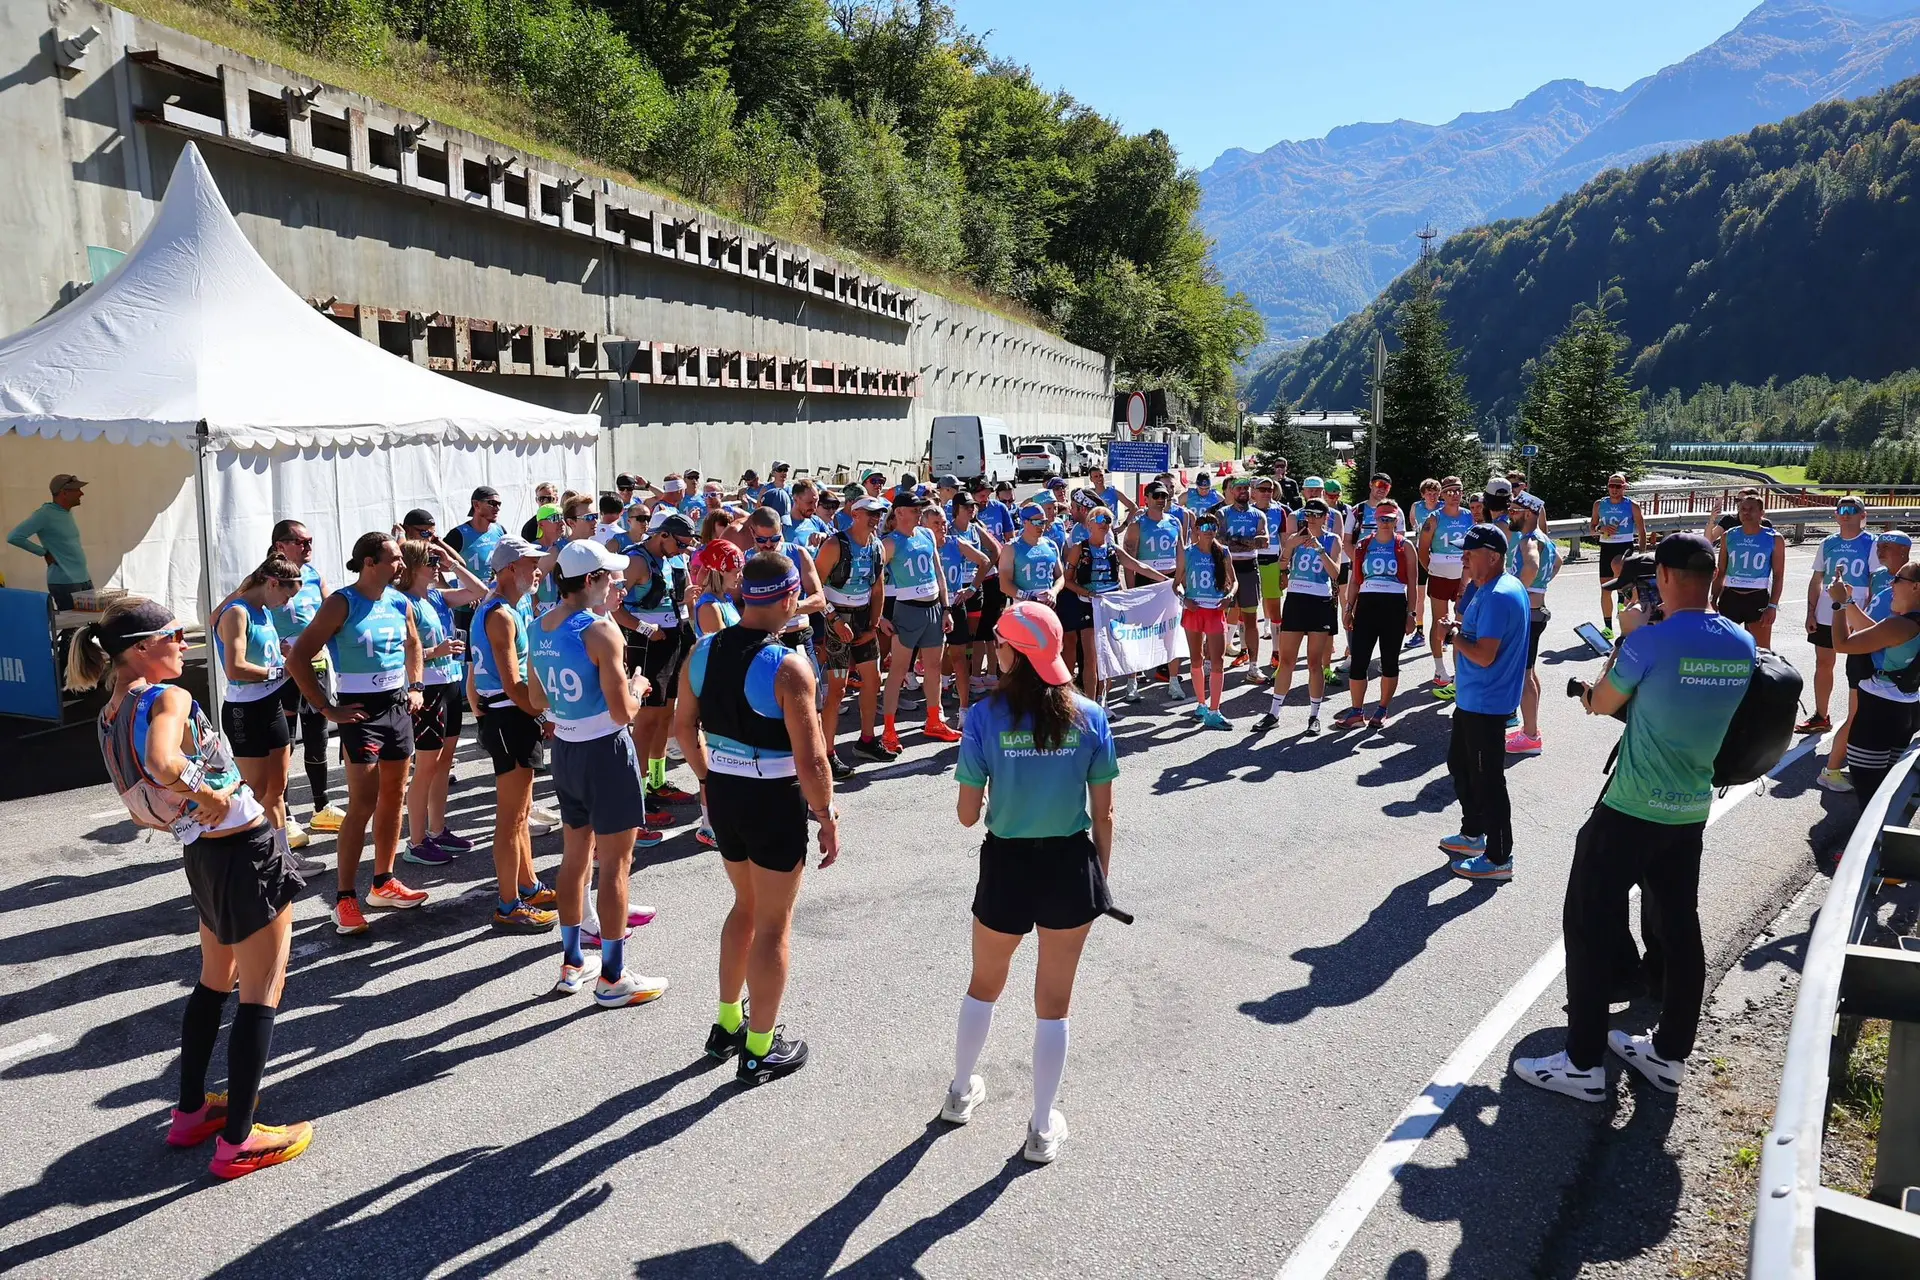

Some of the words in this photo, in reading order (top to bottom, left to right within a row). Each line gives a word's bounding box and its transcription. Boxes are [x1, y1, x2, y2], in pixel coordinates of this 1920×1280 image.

[1728, 550, 1764, 570] 110
[1190, 570, 1215, 589] 18
[0, 656, 26, 683] НА
[1683, 661, 1720, 673] ЦАРЬ
[1721, 662, 1750, 674] ГОРЫ
[1680, 676, 1718, 686] ГОНКА
[1719, 678, 1726, 686] В
[1727, 677, 1748, 687] ГОРУ
[1004, 749, 1040, 758] ГОНКА
[716, 755, 757, 767] СТОРИНГ
[1651, 788, 1662, 799] Я
[1665, 791, 1693, 803] ЭТО
